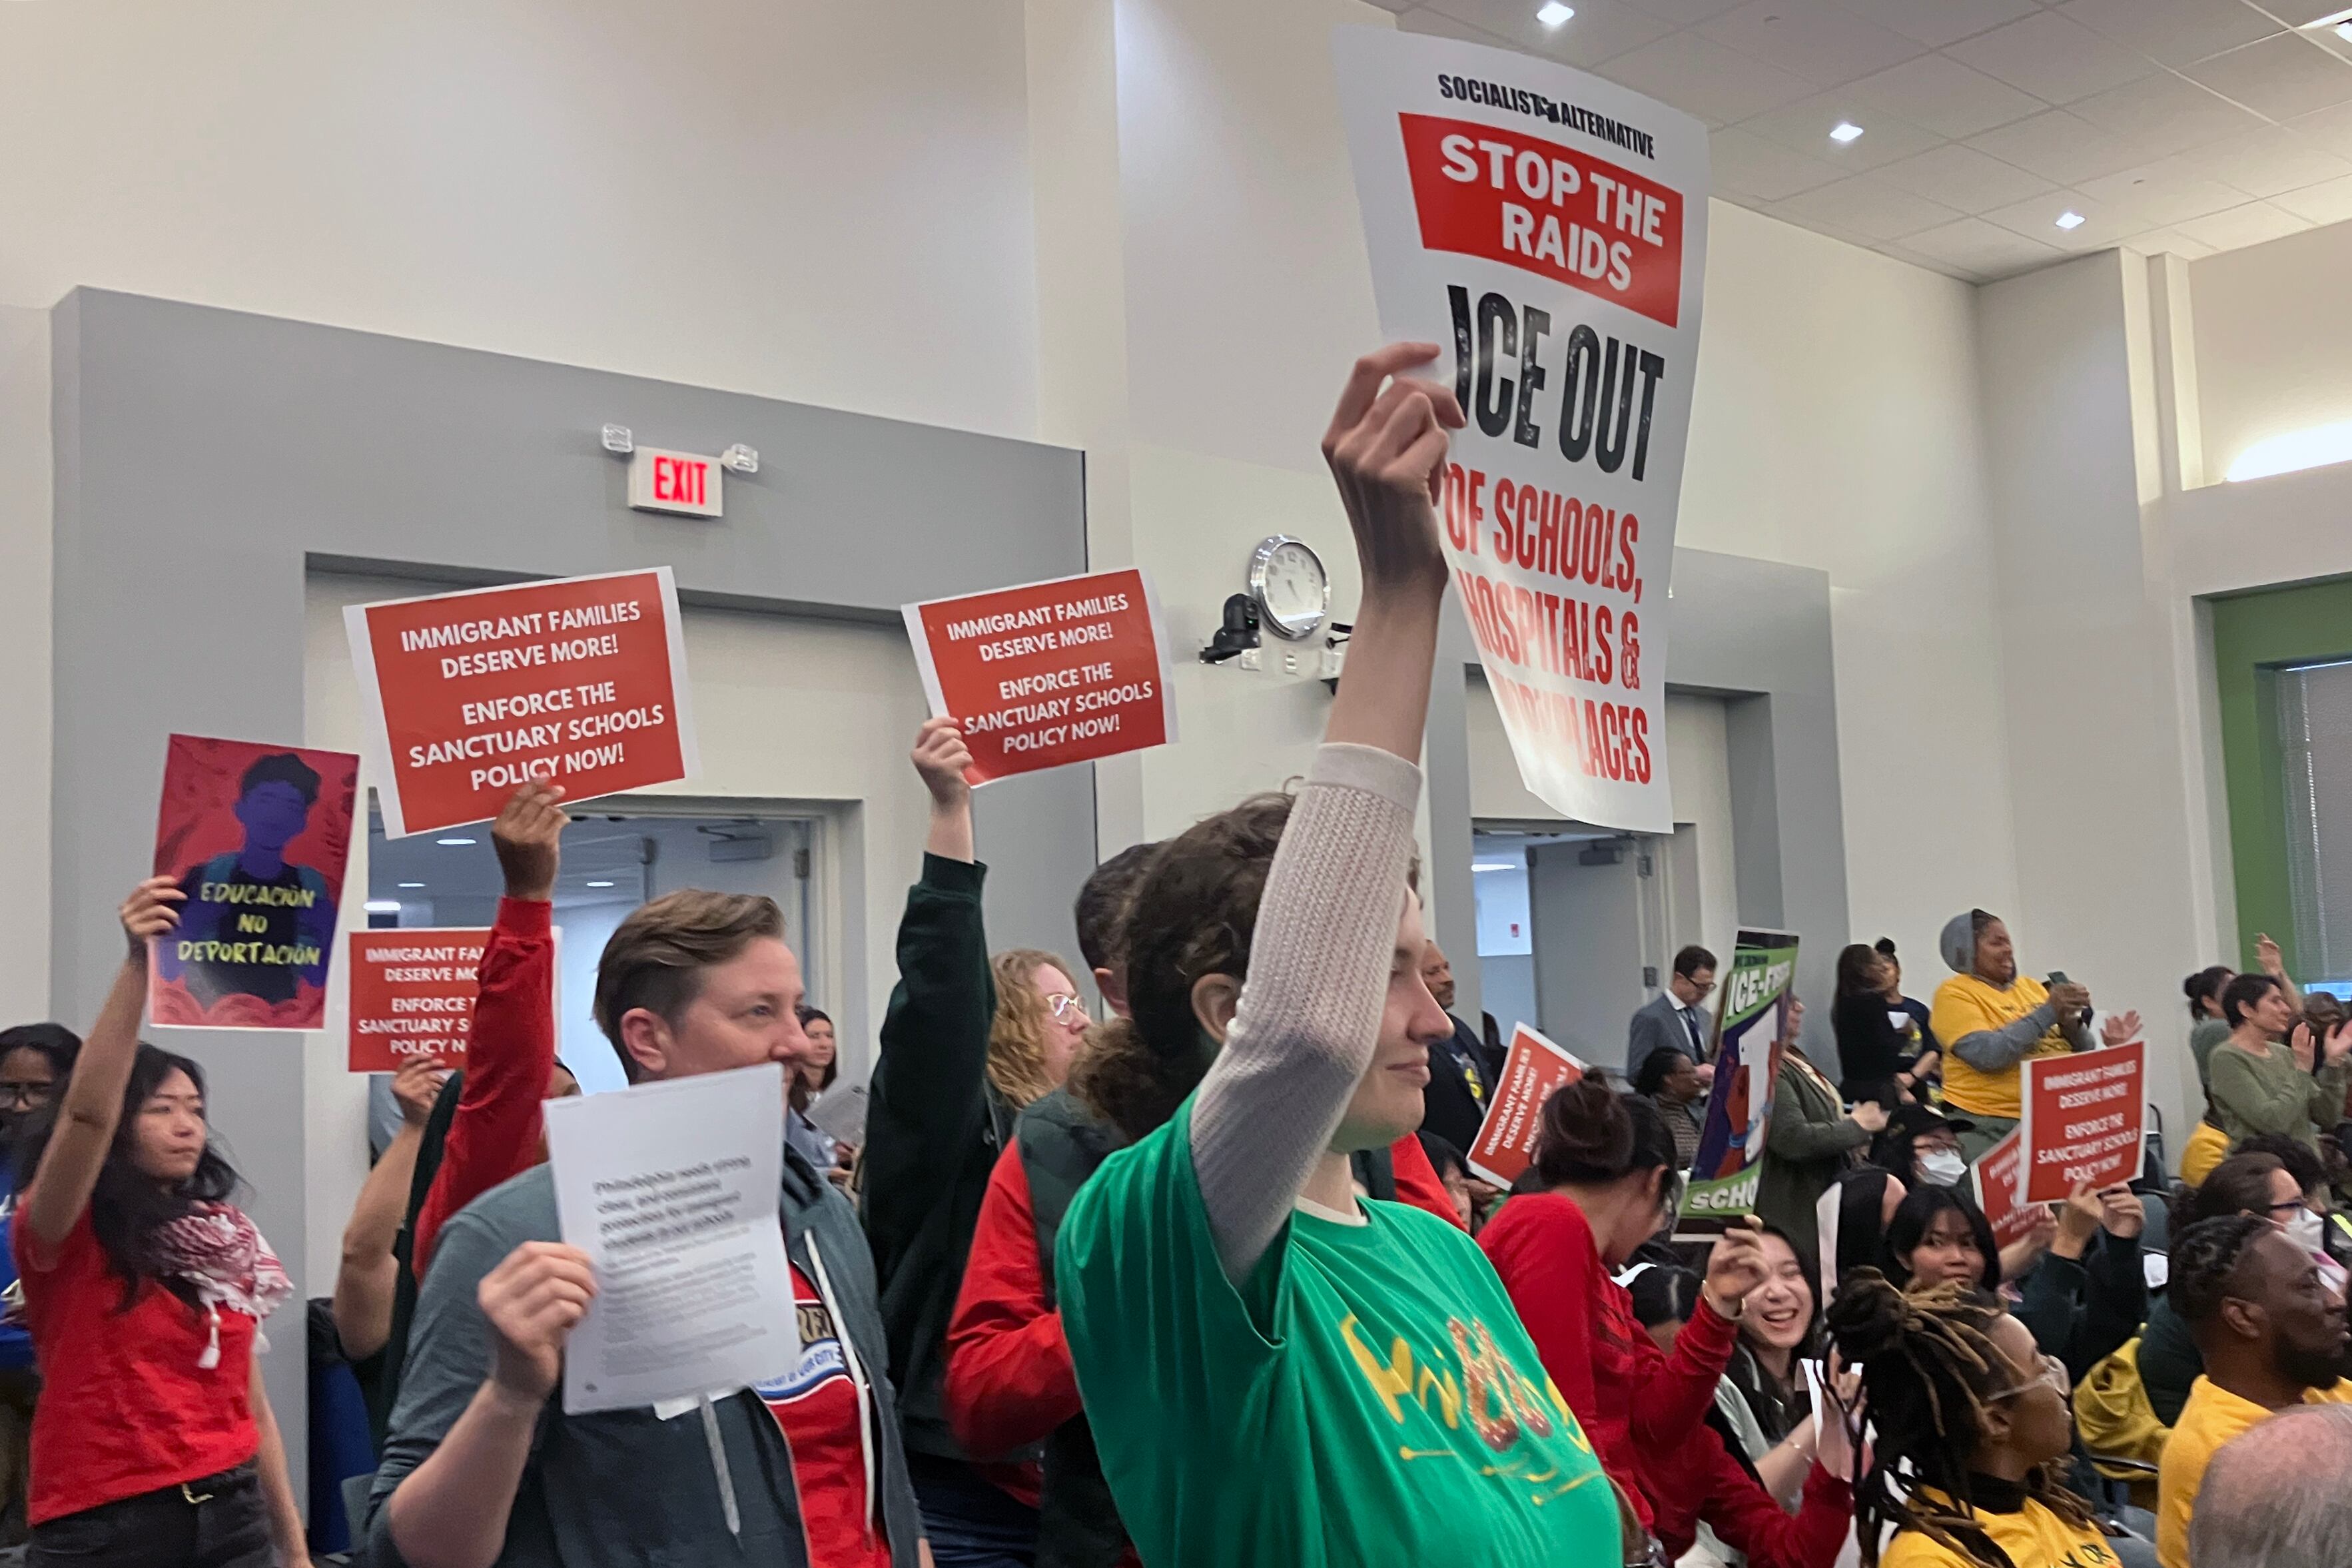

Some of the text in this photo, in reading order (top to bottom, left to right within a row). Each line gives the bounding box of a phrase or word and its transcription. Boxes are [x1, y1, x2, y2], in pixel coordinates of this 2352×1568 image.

[1438, 74, 1655, 160] SOCIALIST ALTERNATIVE
[1441, 135, 1666, 247] STOP THE
[1502, 201, 1633, 291] RAIDS
[1447, 284, 1665, 482] ICE OUT
[654, 456, 709, 506] EXIT
[1445, 463, 1642, 603] OF SCHOOLS,
[401, 601, 641, 651] IMMIGRANT FAMILIES
[947, 593, 1129, 641] IMMIGRANT FAMILIES
[441, 634, 619, 679] DESERVE MORE!
[979, 622, 1114, 662] DESERVE MORE!
[1621, 611, 1639, 690] &
[462, 681, 616, 725] ENFORCE THE
[999, 662, 1113, 699] ENFORCE THE
[964, 681, 1153, 735] SANCTUARY SCHOOLS
[408, 705, 664, 768] SANCTUARY SCHOOLS
[1002, 713, 1120, 753] POLICY NOW!
[470, 742, 625, 791] POLICY NOW!
[201, 882, 316, 909] EDUCACIÓN
[237, 913, 268, 933] NO
[366, 947, 456, 963] IMMIGRANT
[384, 967, 453, 982] DESERVE
[358, 1018, 455, 1034] SANCTUARY
[392, 997, 467, 1012] ENFORCE
[390, 1039, 448, 1054] POLICY
